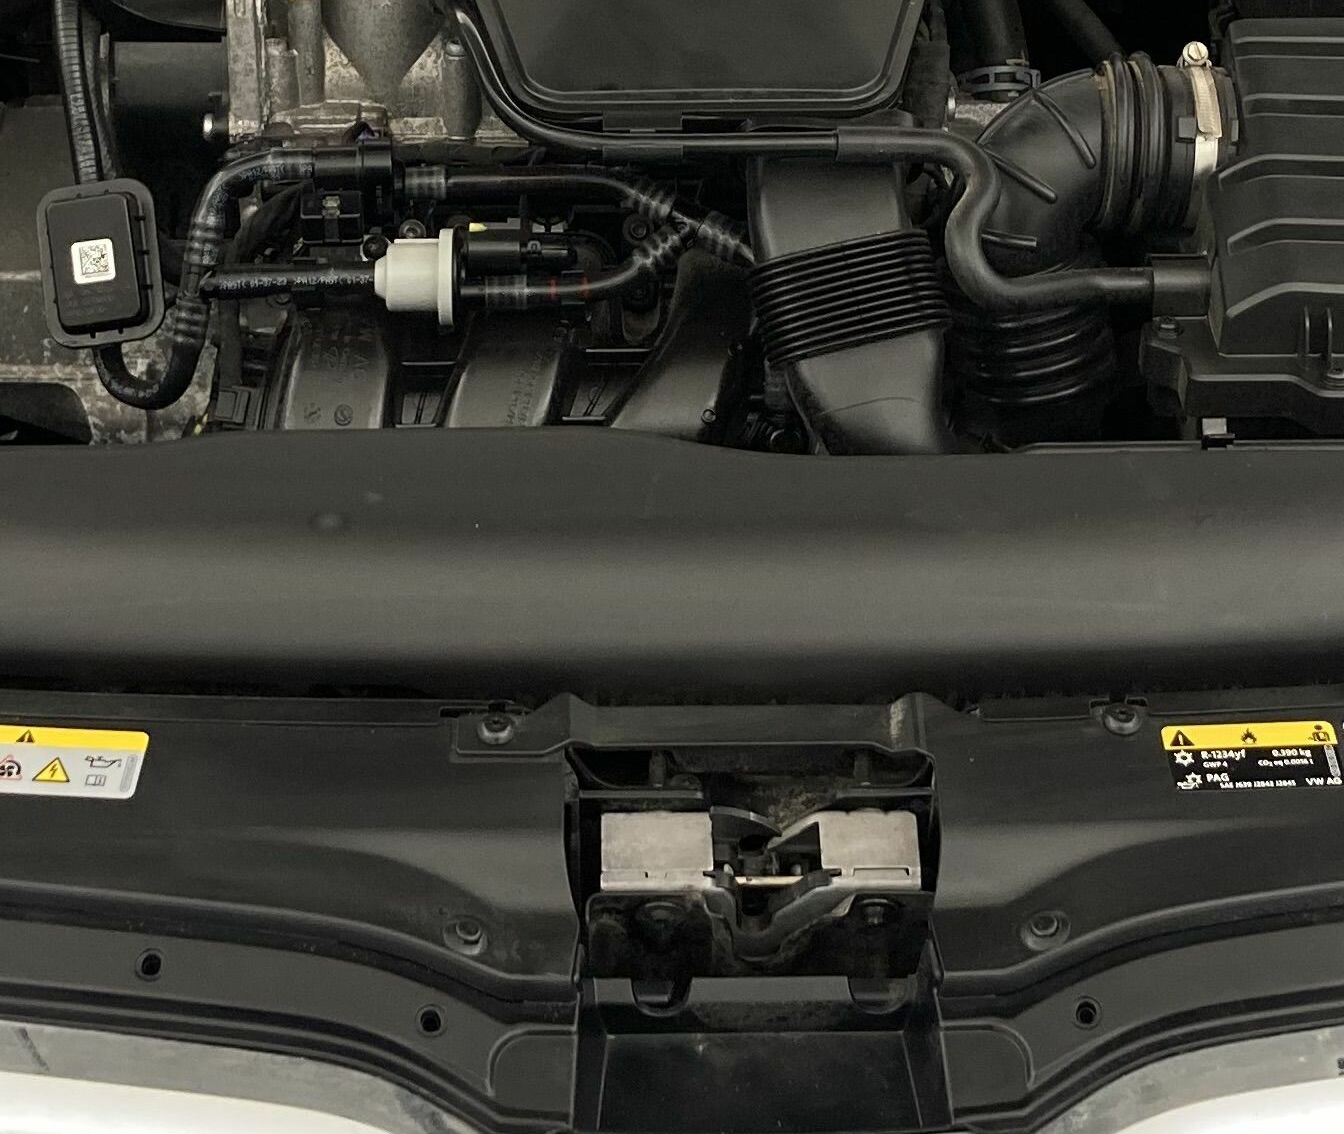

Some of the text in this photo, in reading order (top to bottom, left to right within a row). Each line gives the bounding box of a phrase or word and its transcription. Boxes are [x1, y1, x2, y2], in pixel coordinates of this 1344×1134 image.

[1200, 749, 1246, 761] R-1234yf
[1300, 748, 1312, 758] kg
[1206, 772, 1230, 782] PAG
[1305, 776, 1343, 786] VW AG
